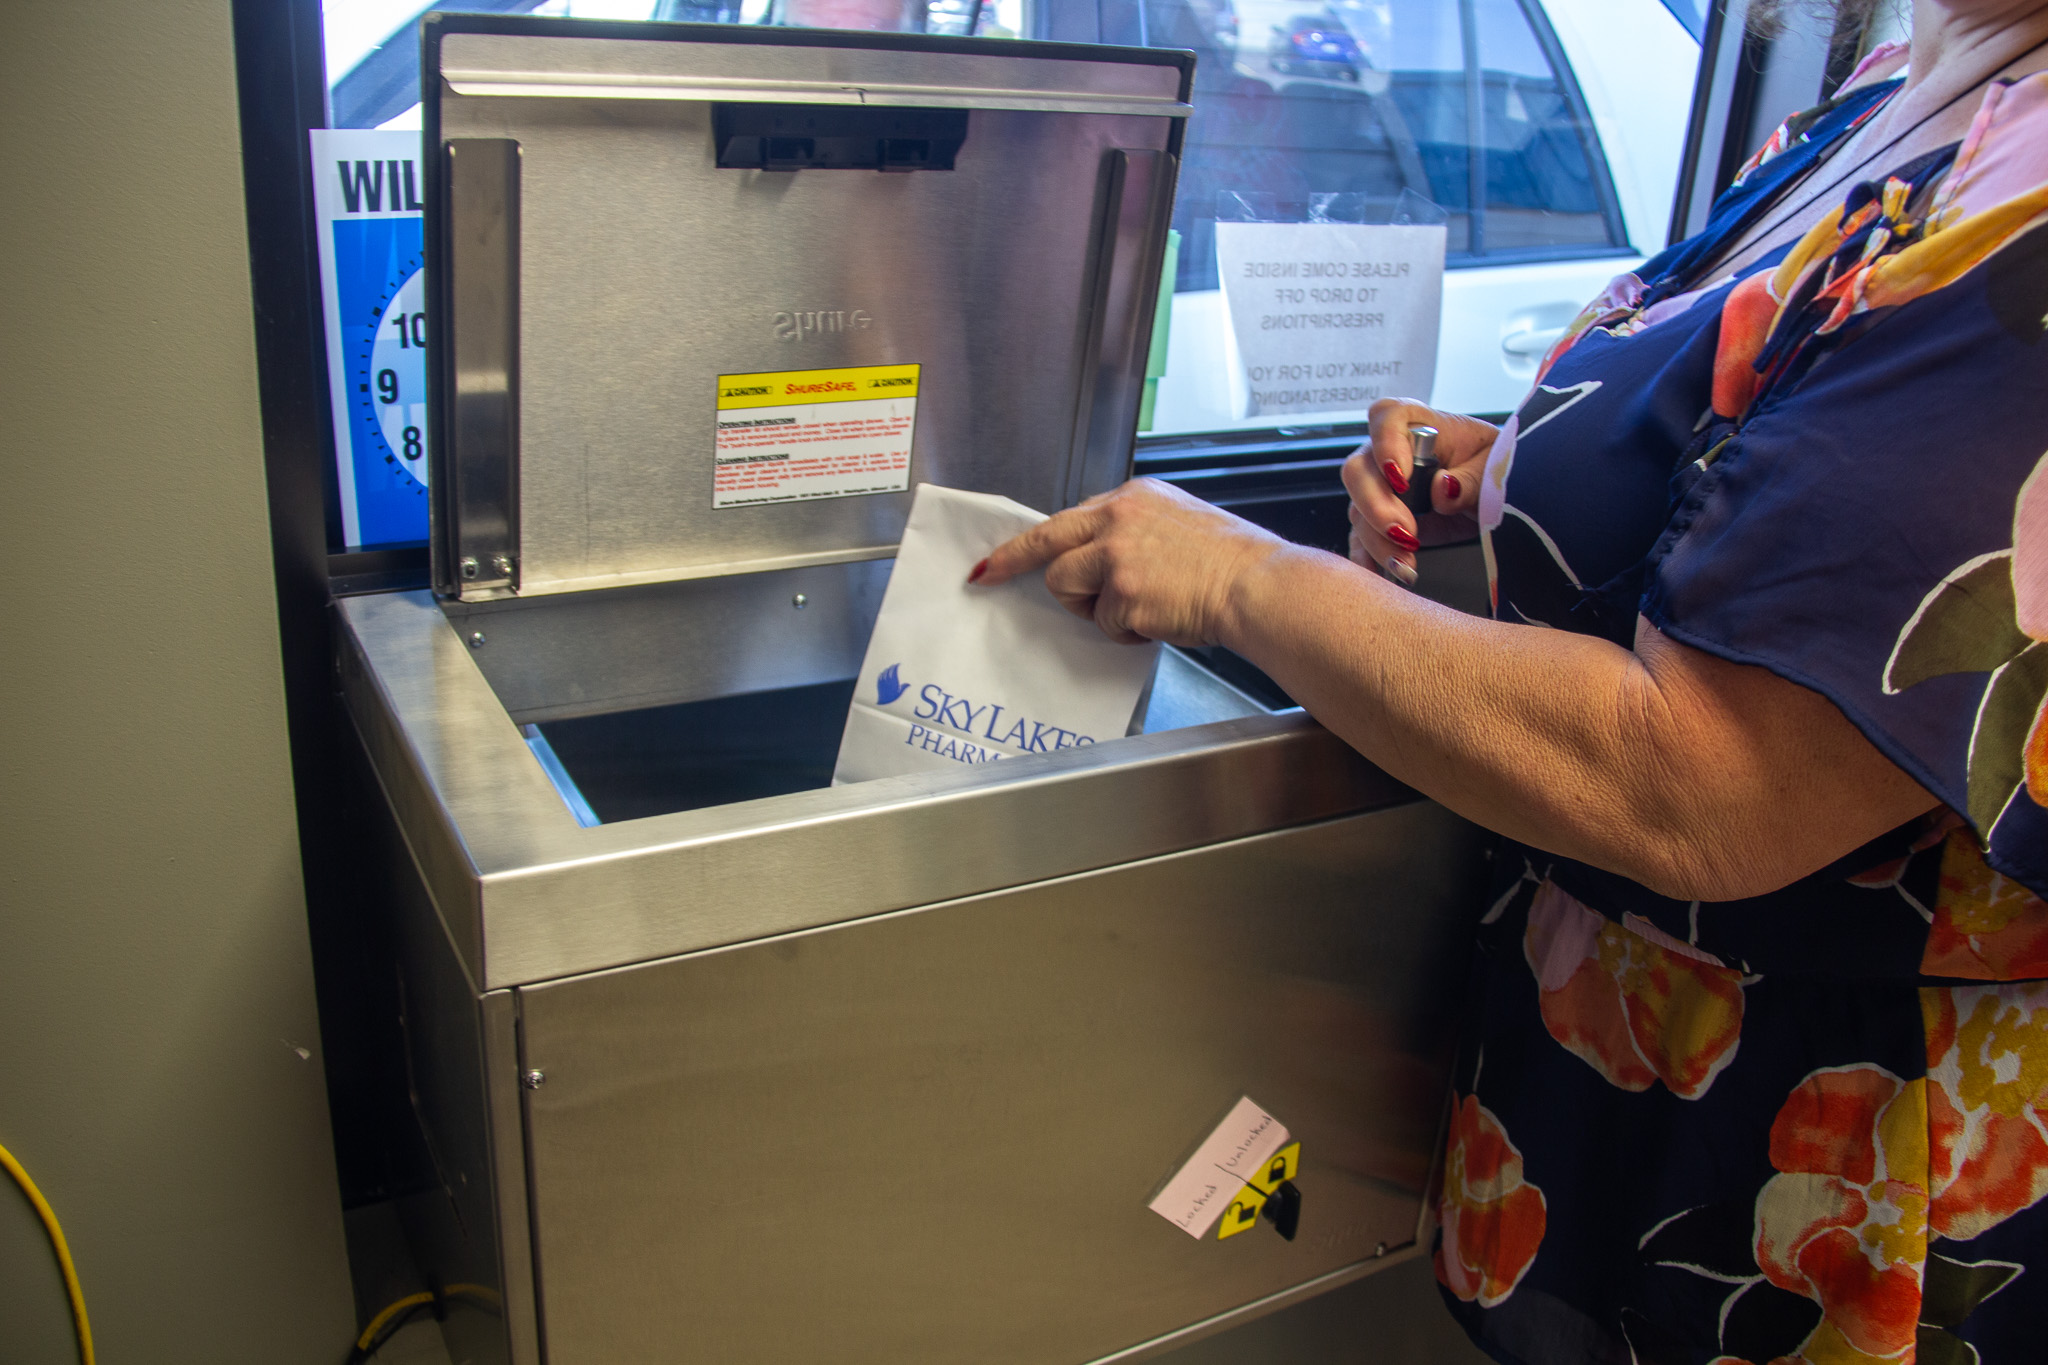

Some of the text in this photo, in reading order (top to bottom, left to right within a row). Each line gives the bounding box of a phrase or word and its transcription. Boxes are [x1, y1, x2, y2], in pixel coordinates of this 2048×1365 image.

[378, 368, 400, 405] 9
[402, 426, 422, 462] 8
[1226, 1115, 1273, 1167] Unlocked
[1175, 1184, 1217, 1228] Locked
